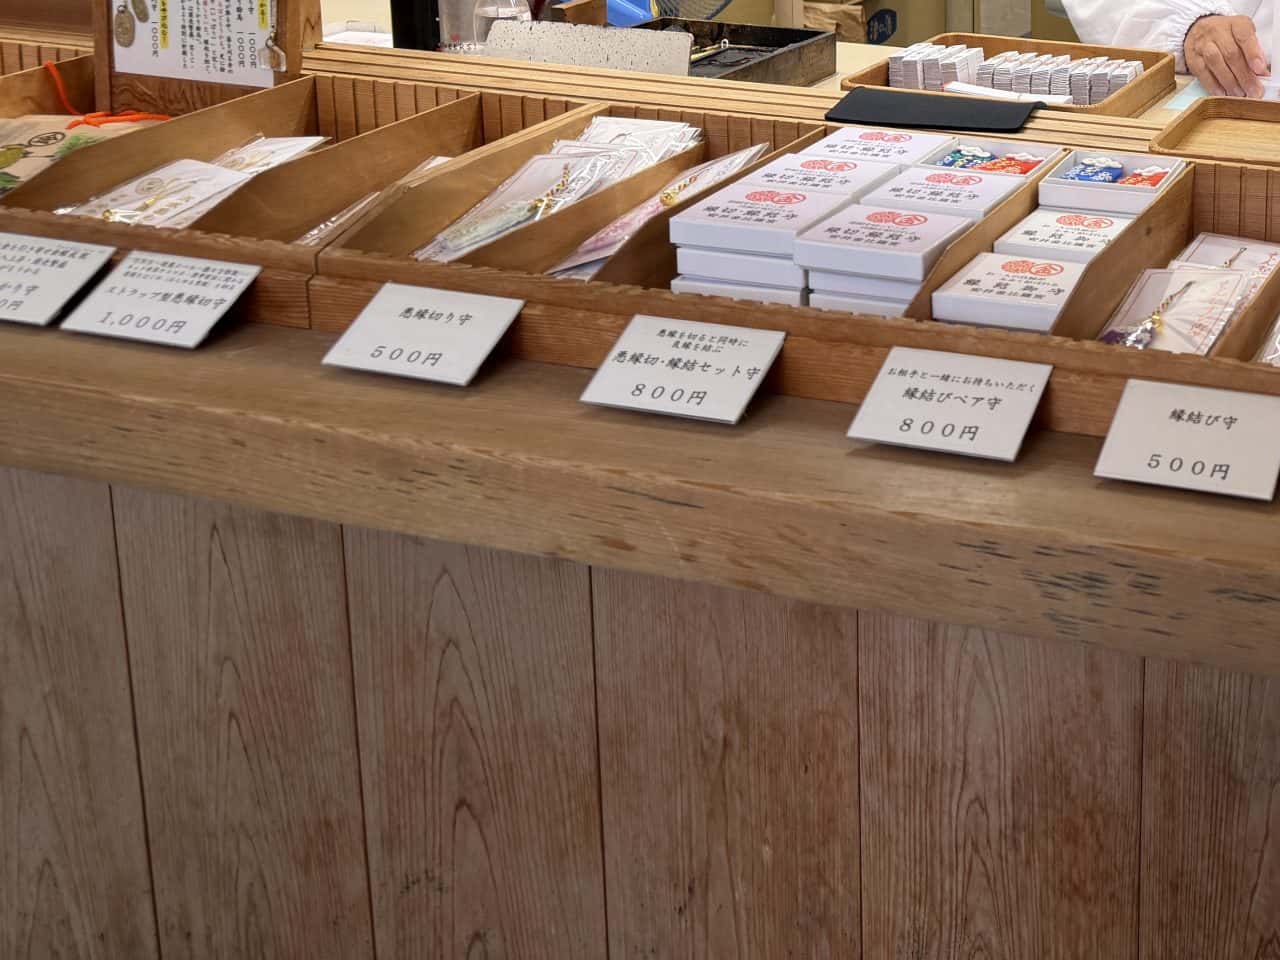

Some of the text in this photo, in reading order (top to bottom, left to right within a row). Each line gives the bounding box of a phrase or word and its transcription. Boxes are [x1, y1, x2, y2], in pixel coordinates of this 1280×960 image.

[98, 311, 188, 334] 1,000円
[399, 306, 473, 326] 悪縁切り守
[370, 345, 443, 367] 500円
[887, 367, 1037, 393] お相手と一緒にお持ちいただく
[631, 383, 708, 406] 800円
[902, 387, 1002, 411] 縁結びペア守
[899, 418, 979, 441] 800円
[1169, 408, 1238, 430] 縁結び守
[1147, 453, 1230, 480] 500円
